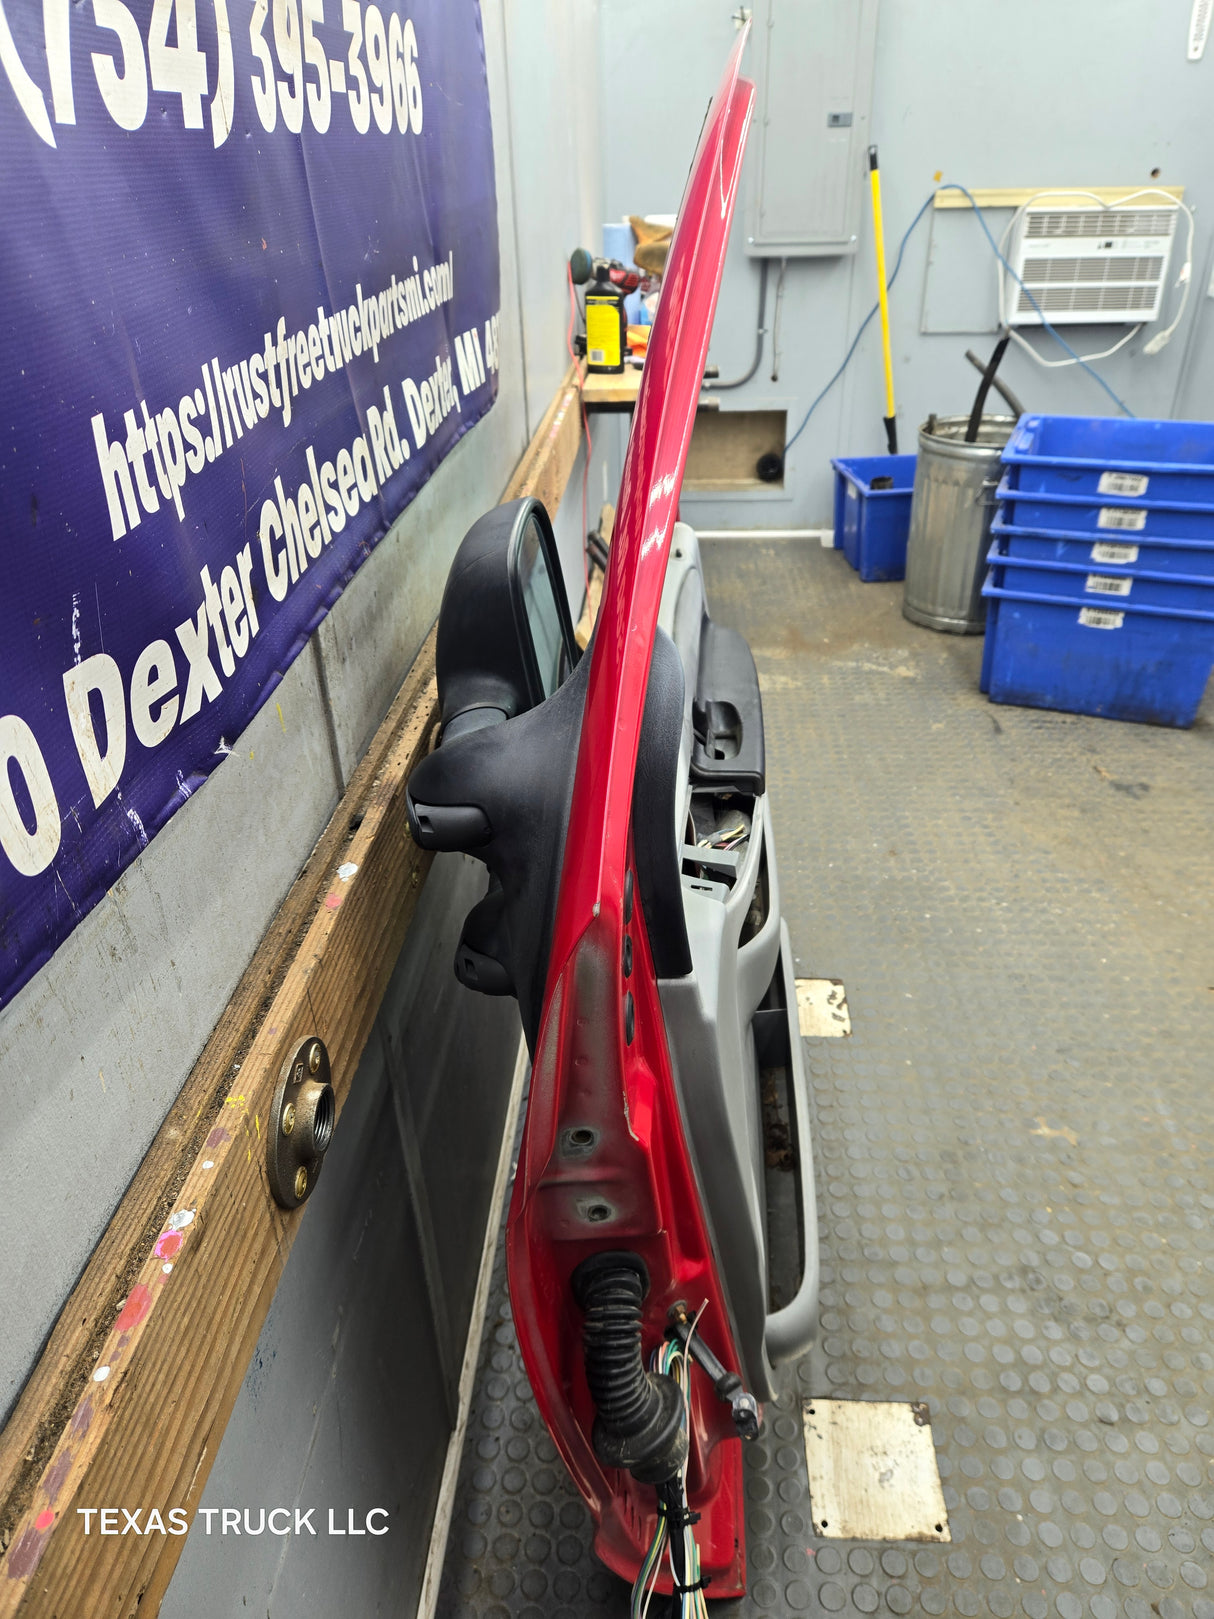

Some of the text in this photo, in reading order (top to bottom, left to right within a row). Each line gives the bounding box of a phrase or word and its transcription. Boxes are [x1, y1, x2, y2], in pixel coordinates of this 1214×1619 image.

[249, 0, 423, 135] 395-3966
[62, 542, 260, 810] Dexter
[259, 433, 378, 602] Chelsea
[366, 385, 411, 485] Rd.
[454, 327, 486, 396] MI
